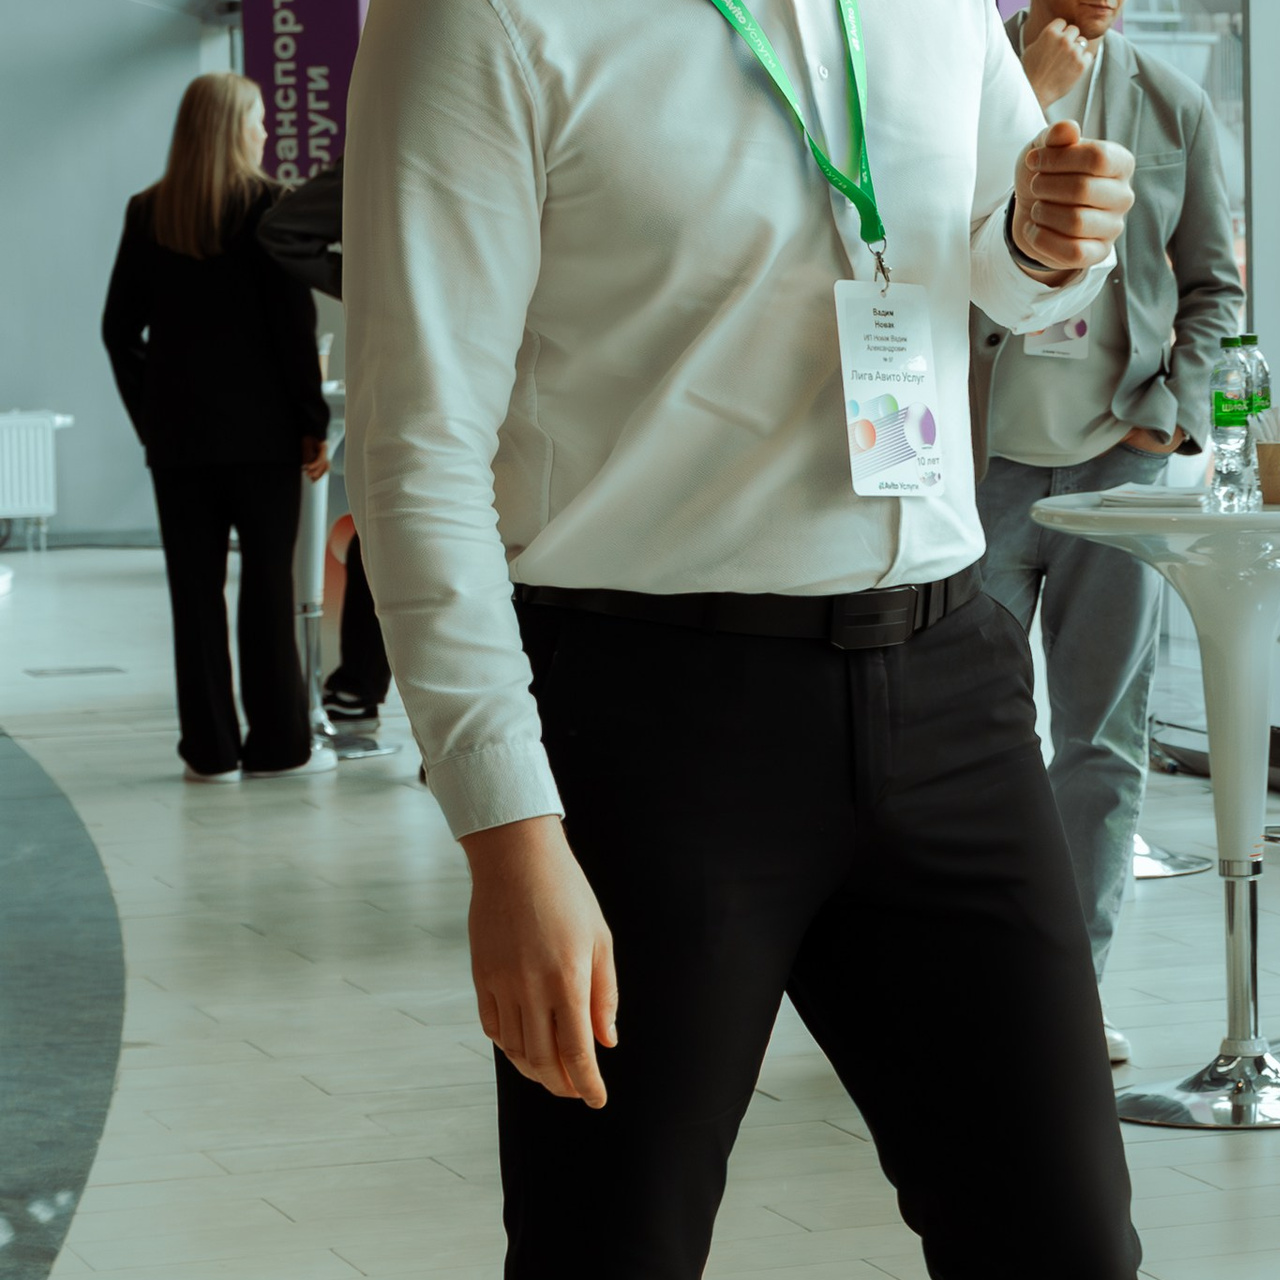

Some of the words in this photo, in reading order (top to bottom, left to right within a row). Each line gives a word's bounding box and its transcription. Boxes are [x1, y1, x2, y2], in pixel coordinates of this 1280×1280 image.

[847, 7, 858, 38] Avito
[744, 23, 776, 68] Услуги
[851, 370, 873, 380] Лига
[875, 371, 901, 381] Авито
[902, 372, 925, 385] Услуг
[917, 457, 925, 466] 10
